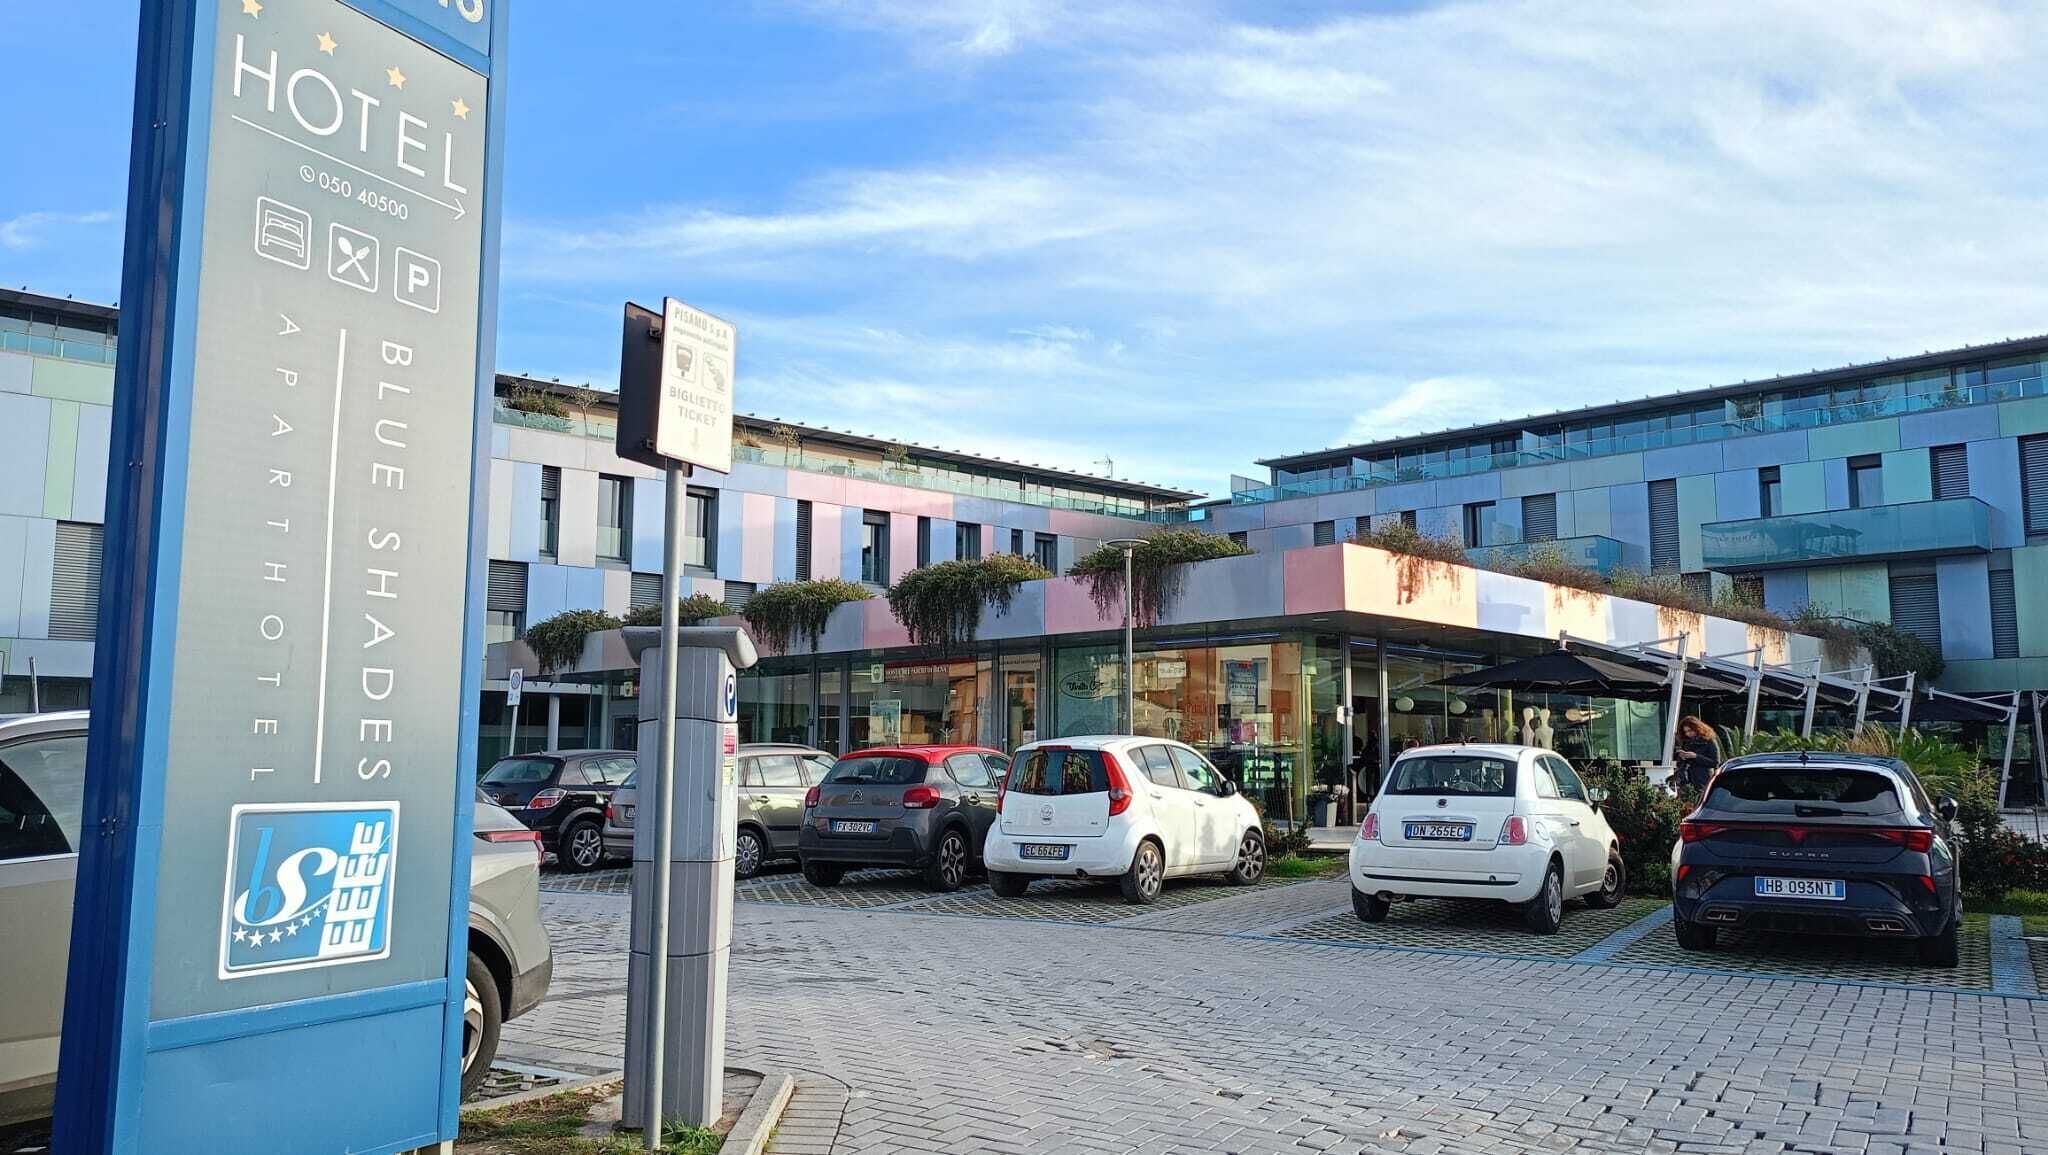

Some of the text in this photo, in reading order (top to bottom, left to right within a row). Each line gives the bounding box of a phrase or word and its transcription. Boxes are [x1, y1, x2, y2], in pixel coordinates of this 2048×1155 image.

[233, 34, 467, 195] HOTEL
[319, 172, 409, 220] 050 40500
[408, 264, 430, 293] P
[669, 386, 726, 415] BIGLIETTO
[678, 406, 717, 428] TICKET
[251, 313, 301, 781] APARTHOTEL
[358, 339, 414, 780] BLUE SHADES
[1412, 824, 1464, 837] DN 265EC
[1766, 879, 1833, 895] HB 093NT
